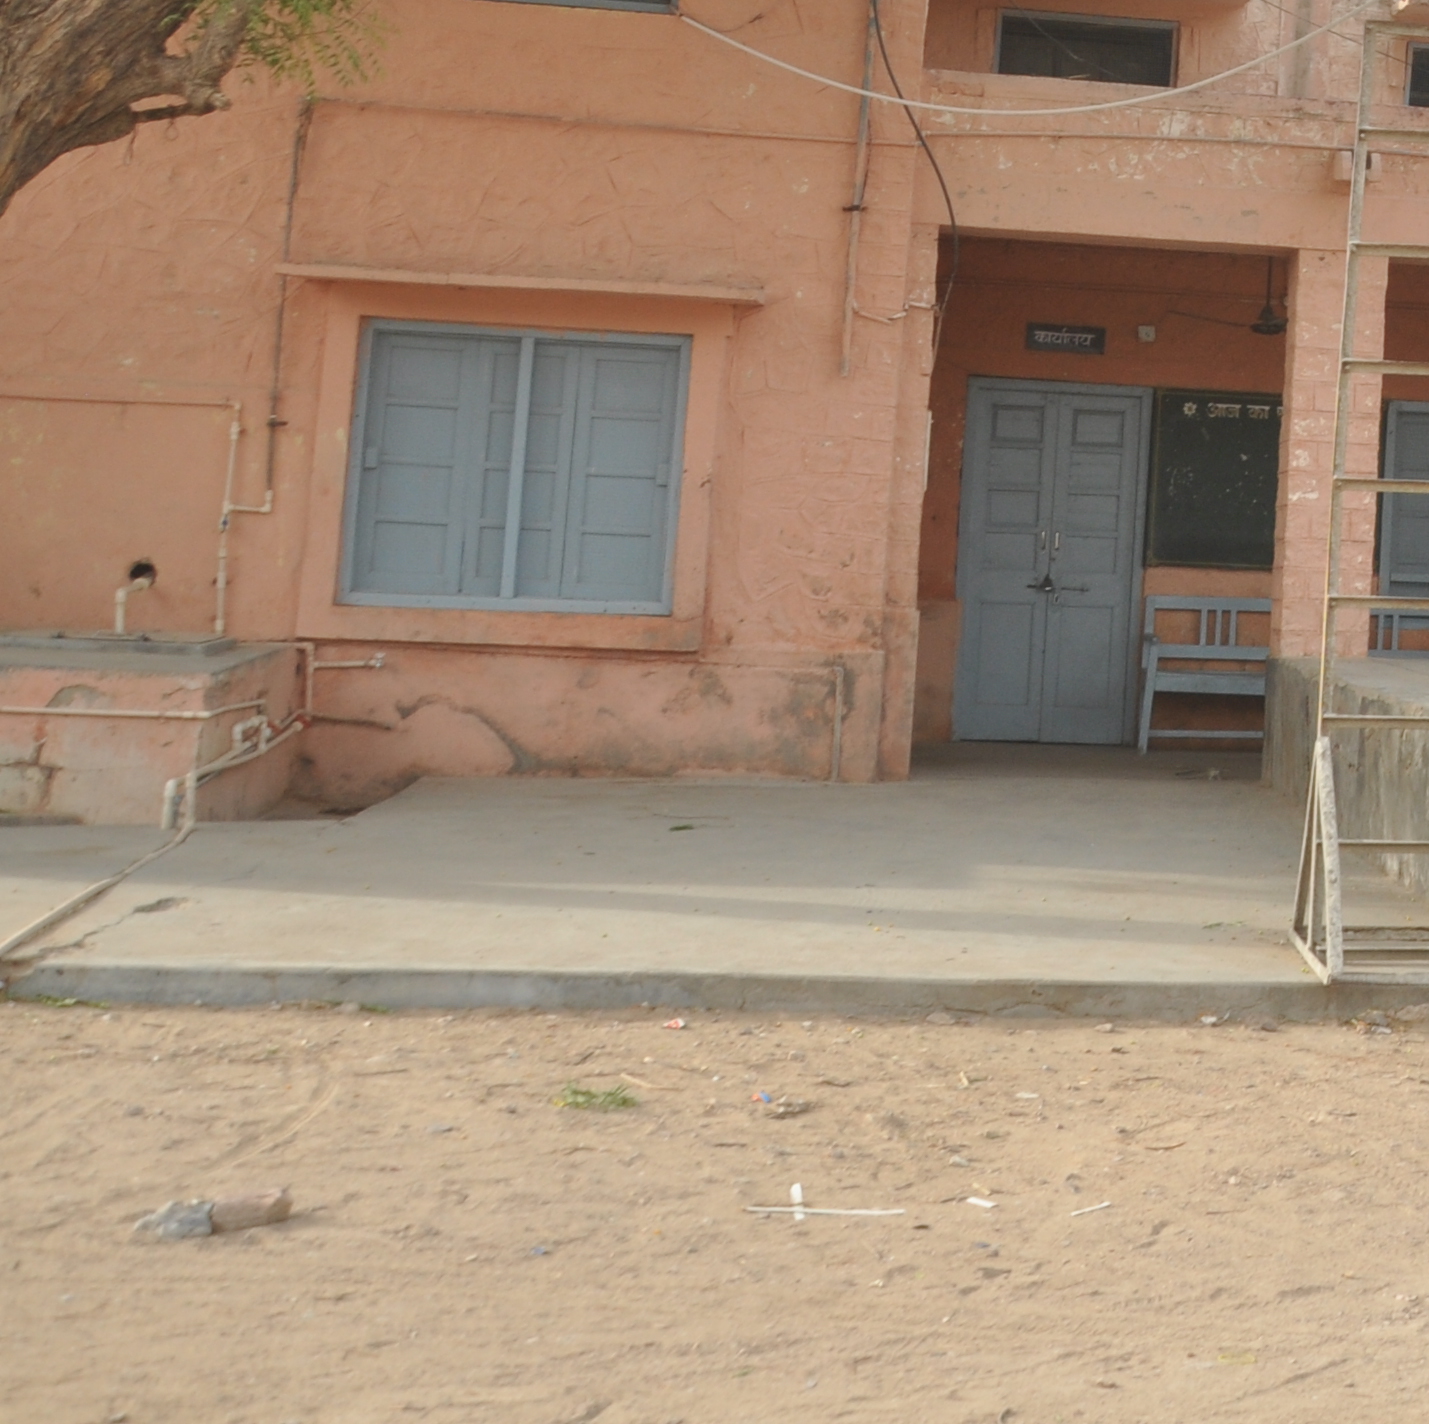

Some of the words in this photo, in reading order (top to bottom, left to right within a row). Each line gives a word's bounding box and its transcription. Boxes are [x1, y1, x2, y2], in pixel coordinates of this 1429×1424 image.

[1034, 327, 1096, 346] कार्यालय
[1206, 402, 1242, 418] आज
[1247, 404, 1271, 419] का
